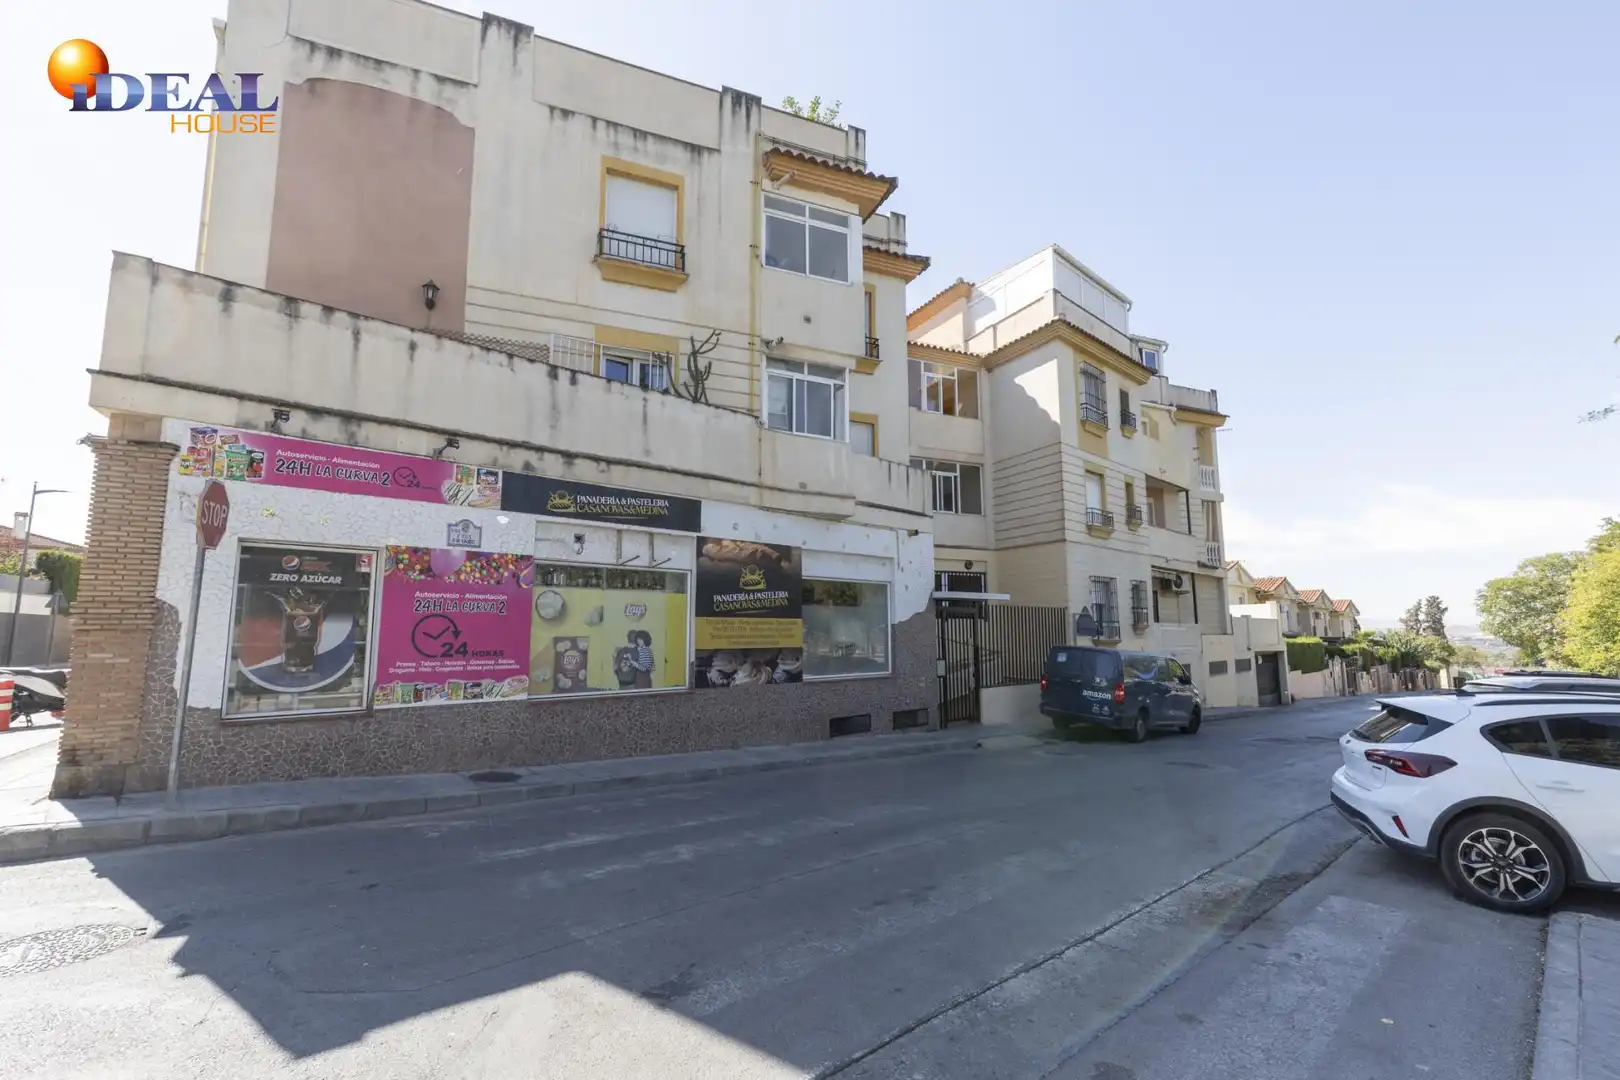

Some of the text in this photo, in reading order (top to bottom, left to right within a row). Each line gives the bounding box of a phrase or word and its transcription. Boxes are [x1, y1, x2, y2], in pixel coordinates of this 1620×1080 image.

[276, 449, 326, 462] Autoservicio
[332, 456, 380, 469] Alimentación
[274, 457, 391, 487] 24H LA CURVA 2
[202, 500, 228, 527] STOP
[269, 572, 342, 585] ZERO AZÚCAR
[415, 590, 460, 599] Autoservicio
[414, 599, 507, 615] 24H LA CURVA 2
[440, 641, 469, 658] 24
[1082, 690, 1112, 700] amazon
